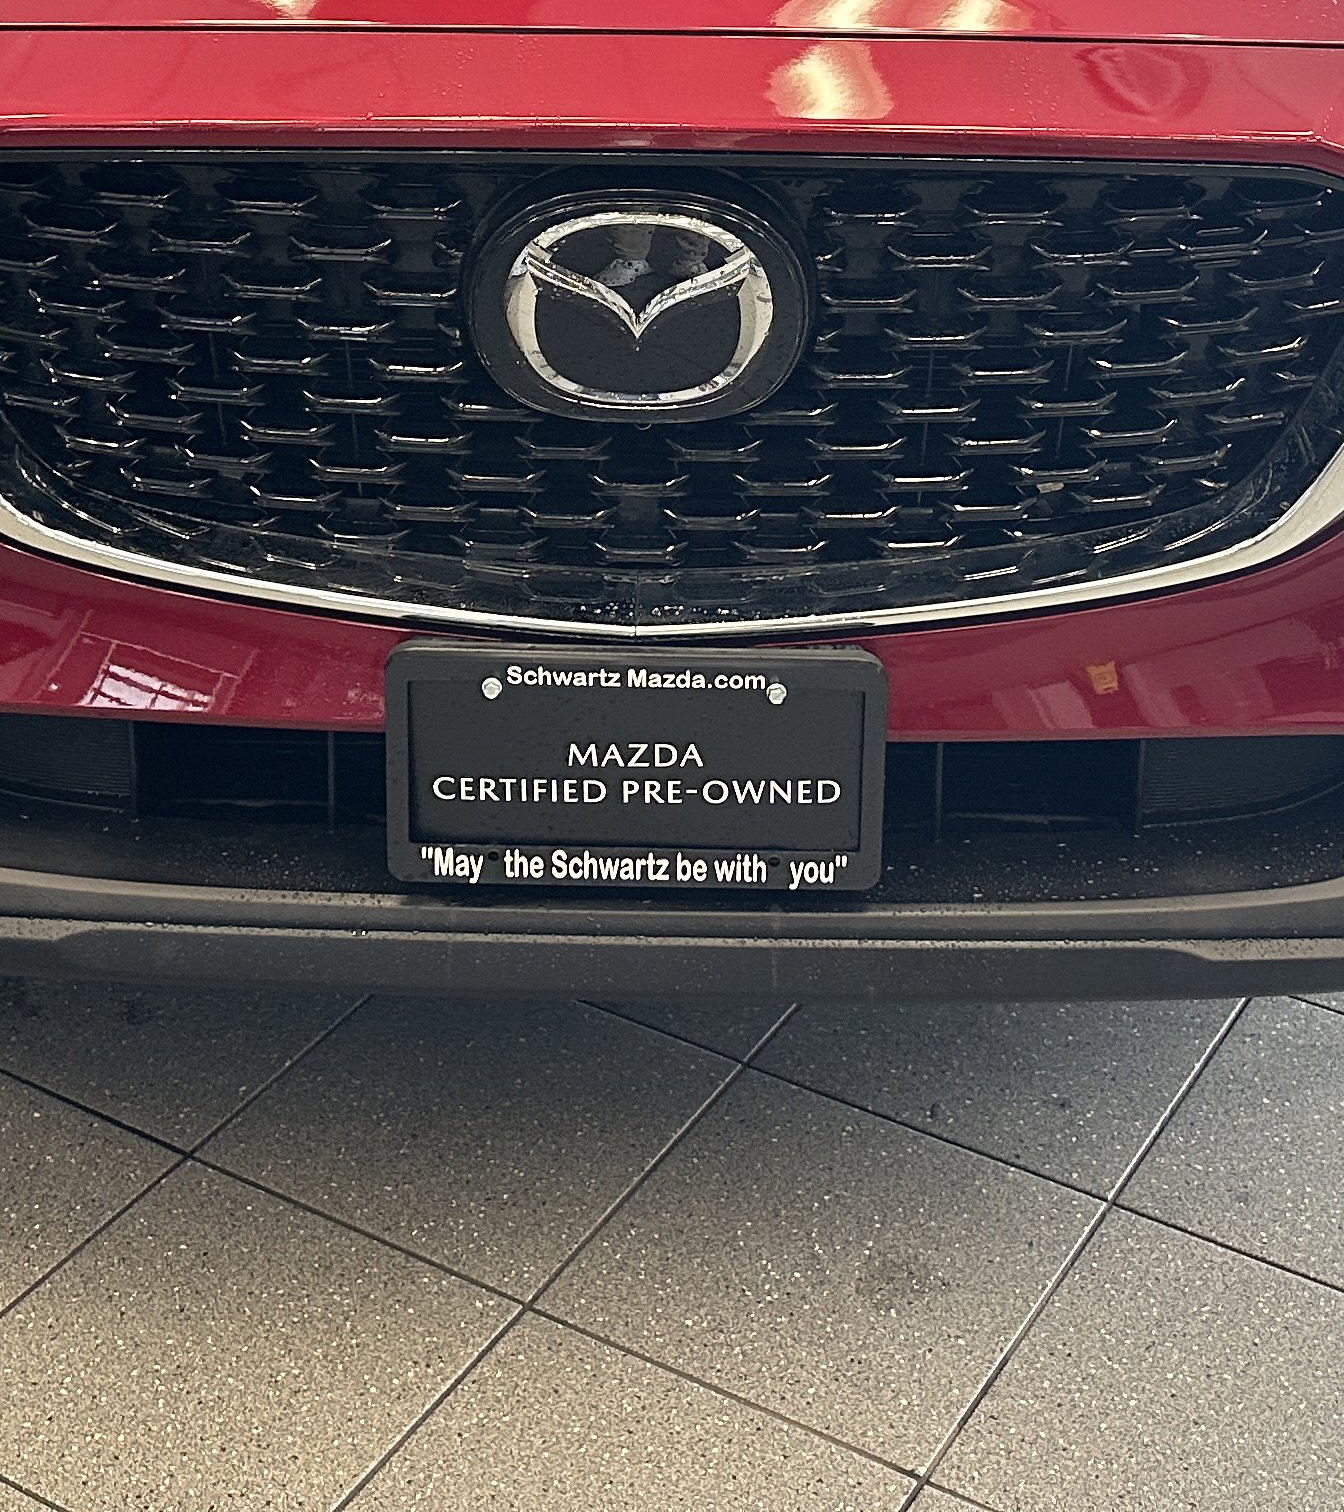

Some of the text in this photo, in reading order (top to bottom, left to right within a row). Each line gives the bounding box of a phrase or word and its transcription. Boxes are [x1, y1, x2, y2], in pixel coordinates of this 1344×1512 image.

[506, 665, 766, 690] Schwartz Mazda.com
[567, 743, 704, 769] MAZDA
[432, 776, 842, 805] CERTIFIED PRE-OWNED
[421, 846, 849, 891] "May the Schwartz be with you"
